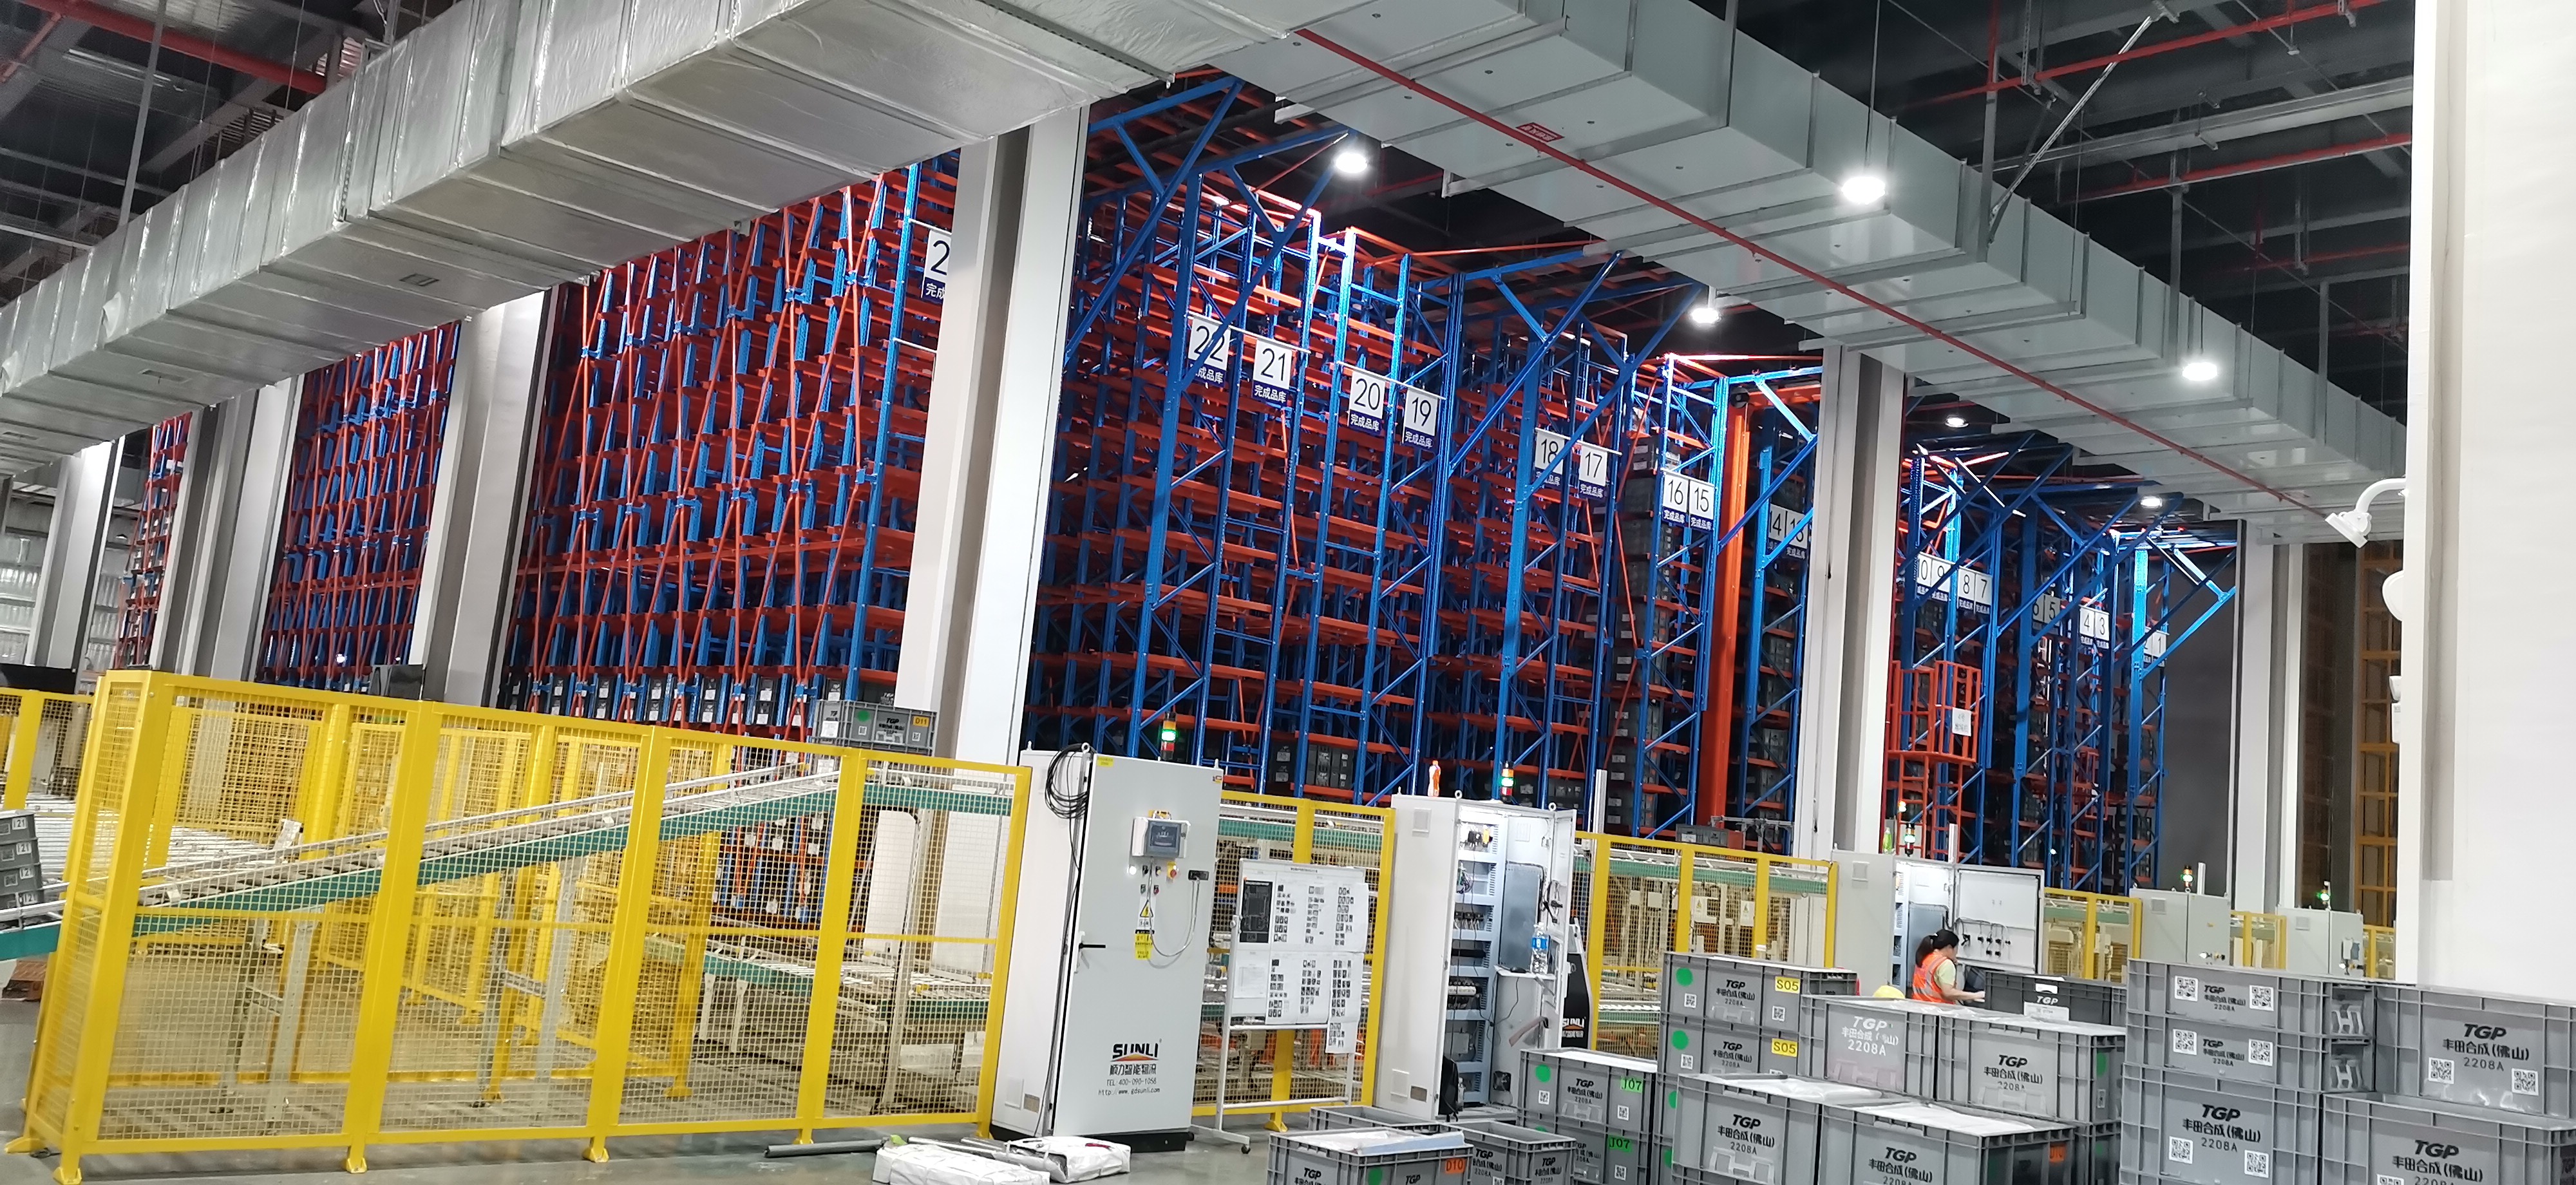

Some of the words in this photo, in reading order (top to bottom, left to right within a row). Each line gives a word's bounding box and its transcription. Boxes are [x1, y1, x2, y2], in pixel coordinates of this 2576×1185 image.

[1194, 325, 1224, 362] 22
[1260, 348, 1286, 381] 21
[1195, 366, 1224, 384] 成品库
[1254, 384, 1287, 404] 完成品库
[1354, 378, 1381, 410] 20
[1412, 397, 1432, 426] 19
[1350, 413, 1380, 432] 完成品库
[1405, 431, 1433, 449] 完成品库
[1541, 439, 1559, 464] 18
[1586, 451, 1603, 478] 17
[1668, 480, 1683, 506] 16
[1694, 487, 1710, 513] 15
[1963, 574, 1970, 594] 8
[1980, 578, 1988, 598] 7
[2084, 612, 2090, 632] 4
[2099, 616, 2106, 636] 3
[1726, 979, 1746, 990] TGP
[1776, 979, 1799, 992] S05
[2204, 985, 2226, 994] TGP
[2036, 995, 2059, 1005] TGP
[1852, 1016, 1888, 1032] TGP
[2463, 1023, 2507, 1041] TGP
[1112, 1043, 1159, 1059] SUNLI
[1722, 1041, 1743, 1052] TGP
[1773, 1041, 1797, 1054] S05
[1848, 1039, 1886, 1056] 2208A
[2202, 1038, 2224, 1048] TGP
[2443, 1038, 2530, 1061] 丰田合成(佛山)
[1998, 1054, 2028, 1068] TGP
[2463, 1057, 2504, 1071] 2208A
[1576, 1077, 1595, 1088] TGP
[1621, 1077, 1642, 1092] J07
[2202, 1103, 2240, 1122] TGP
[1732, 1114, 1761, 1130] TGP
[2182, 1118, 2261, 1143] 丰田合成(佛山)
[1609, 1137, 1631, 1150] J07
[1717, 1124, 1775, 1148] 丰田合成(佛山)
[2201, 1137, 2238, 1153] 2208A
[1475, 1148, 1493, 1159] TGP
[1730, 1141, 1757, 1155] 2208A
[1885, 1146, 1917, 1164] TGP
[2415, 1139, 2459, 1159] TGP
[1446, 1159, 1464, 1171] D10
[1542, 1157, 1556, 1167] TGP
[1868, 1158, 1933, 1183] 丰田合成(佛山)
[2392, 1155, 2483, 1182] 丰田合成(佛山)
[1303, 1167, 1321, 1180] TGP
[1405, 1173, 1421, 1185] TGP
